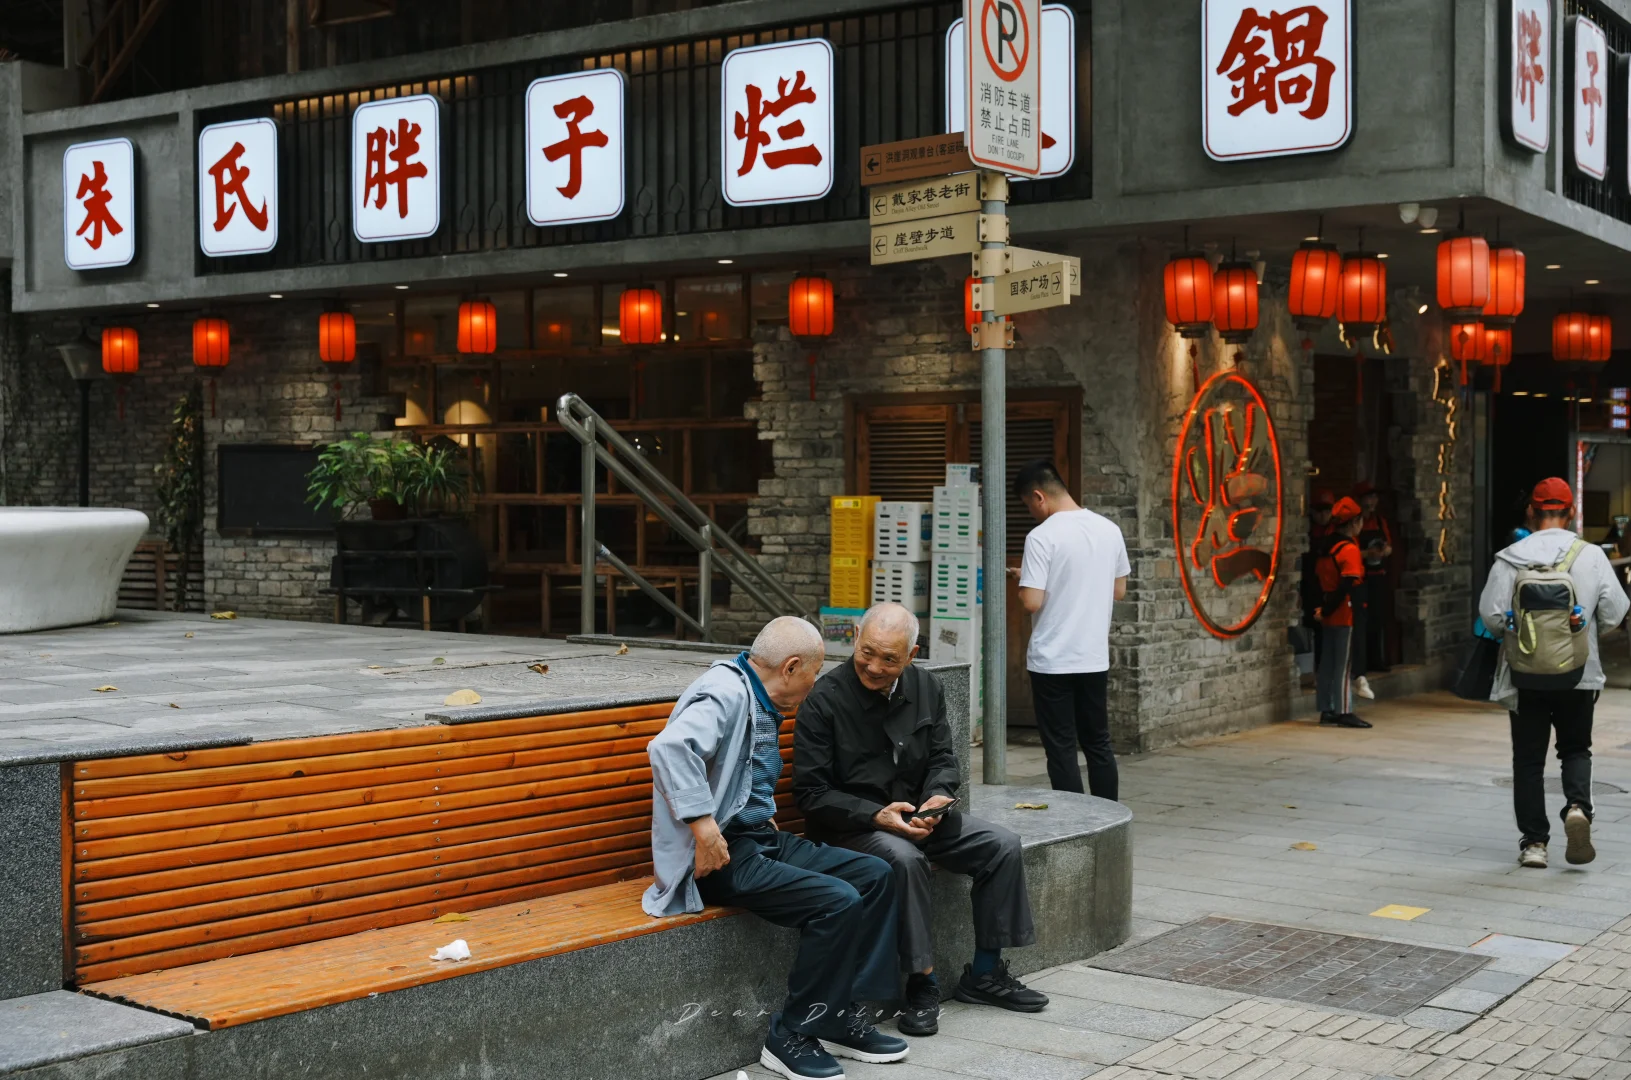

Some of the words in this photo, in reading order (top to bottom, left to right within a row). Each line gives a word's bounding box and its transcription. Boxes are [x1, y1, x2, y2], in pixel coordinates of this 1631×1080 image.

[980, 81, 1031, 114] 消防车道
[980, 106, 1031, 138] 禁止占用
[885, 140, 969, 165] 洪崖洞观景台(客运码
[987, 144, 1005, 156] DON'T
[1006, 149, 1026, 162] OCCUPY
[991, 134, 1005, 145] FIRE
[1006, 138, 1020, 149] LANE
[891, 182, 971, 207] 戴家巷老街
[893, 225, 956, 248] 崖壁步道
[1010, 274, 1049, 296] 国泰广场
